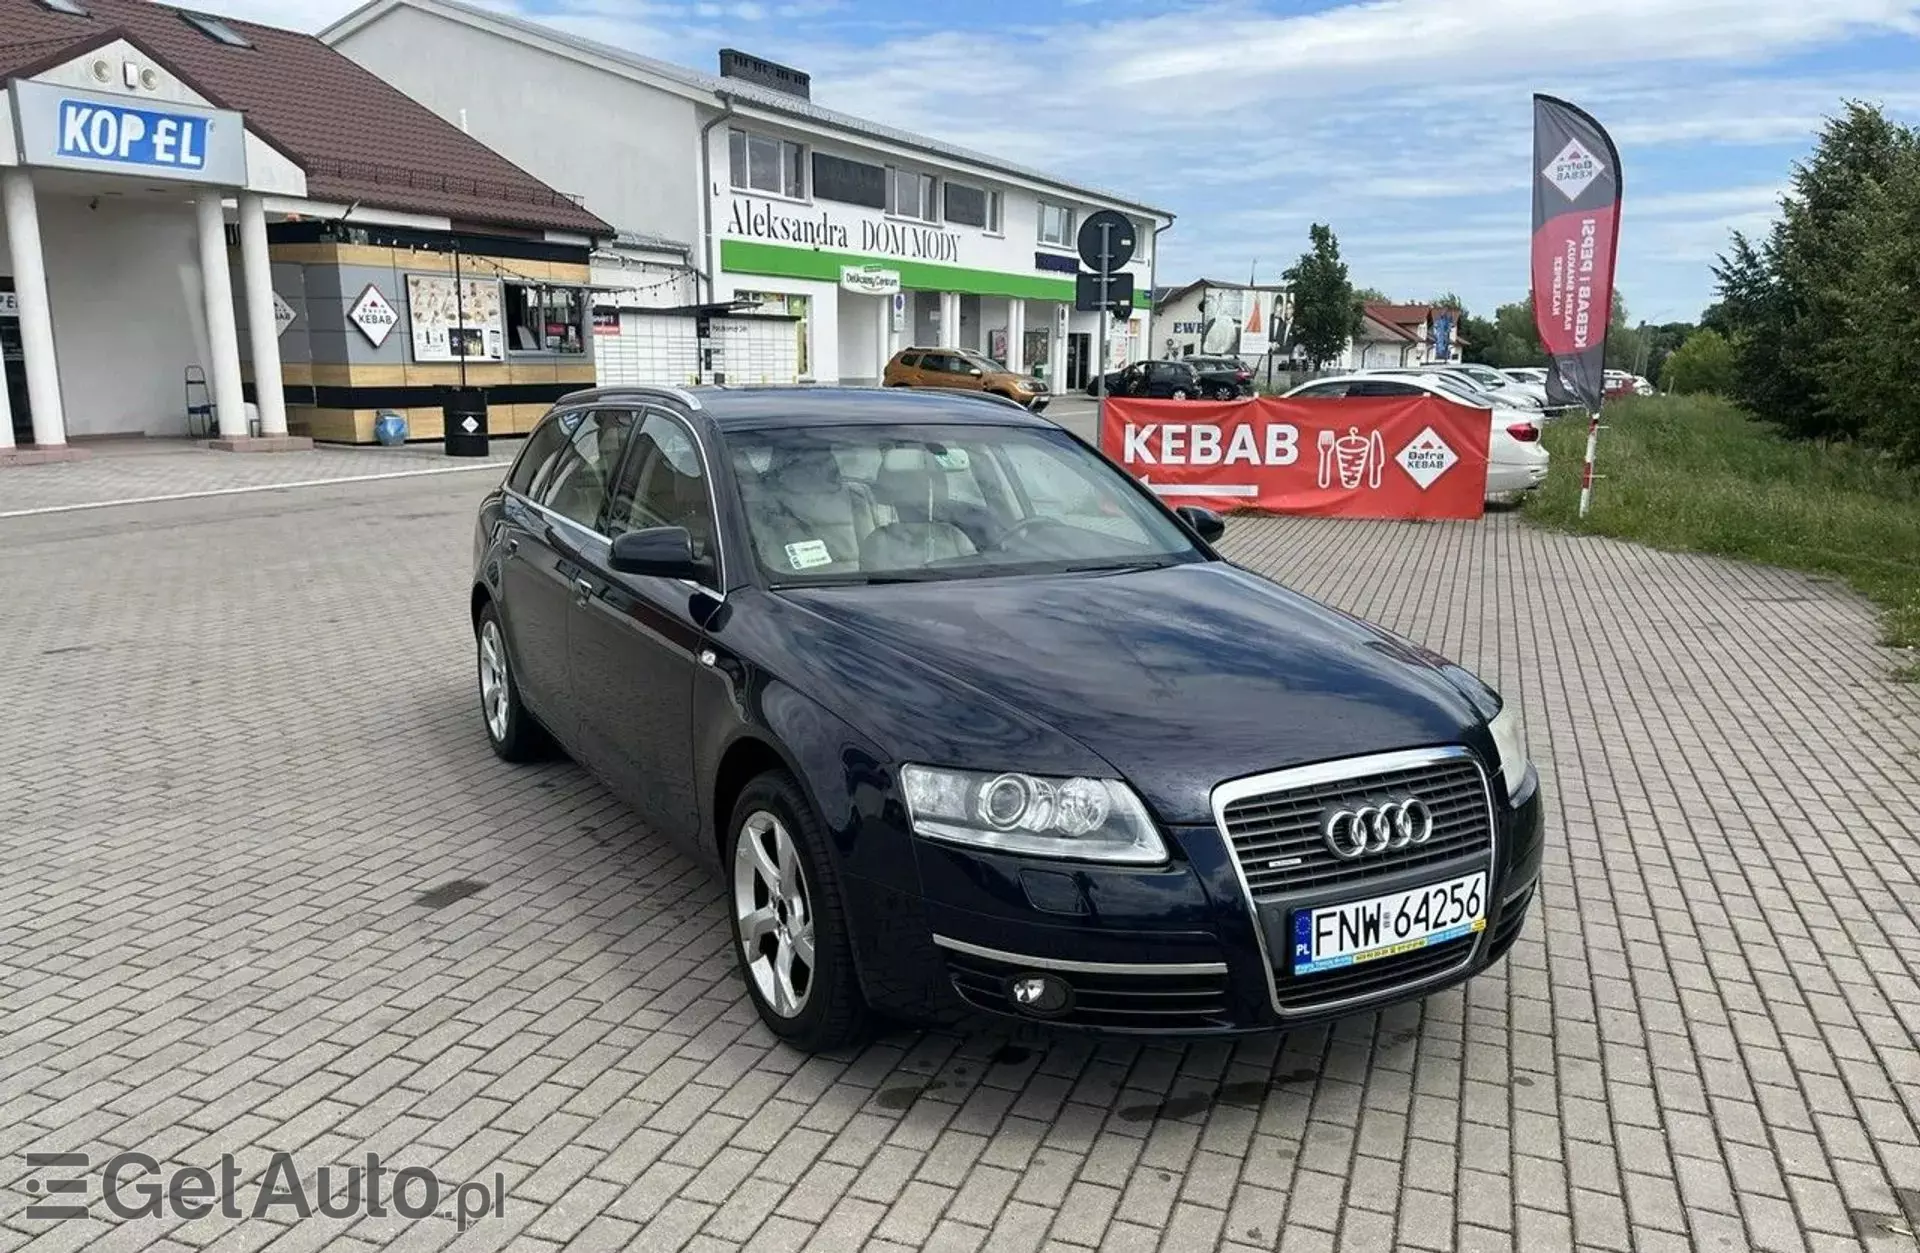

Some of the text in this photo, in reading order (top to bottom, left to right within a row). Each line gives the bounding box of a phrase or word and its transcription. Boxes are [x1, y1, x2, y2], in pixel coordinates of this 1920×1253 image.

[727, 198, 960, 262] Aleksandra DOM MODY
[358, 314, 393, 325] KEBAB
[1124, 423, 1299, 465] KEBAB
[1408, 460, 1444, 469] KEBAB
[1315, 902, 1381, 956] FNW
[1394, 877, 1481, 938] 64256
[1296, 943, 1310, 956] PL
